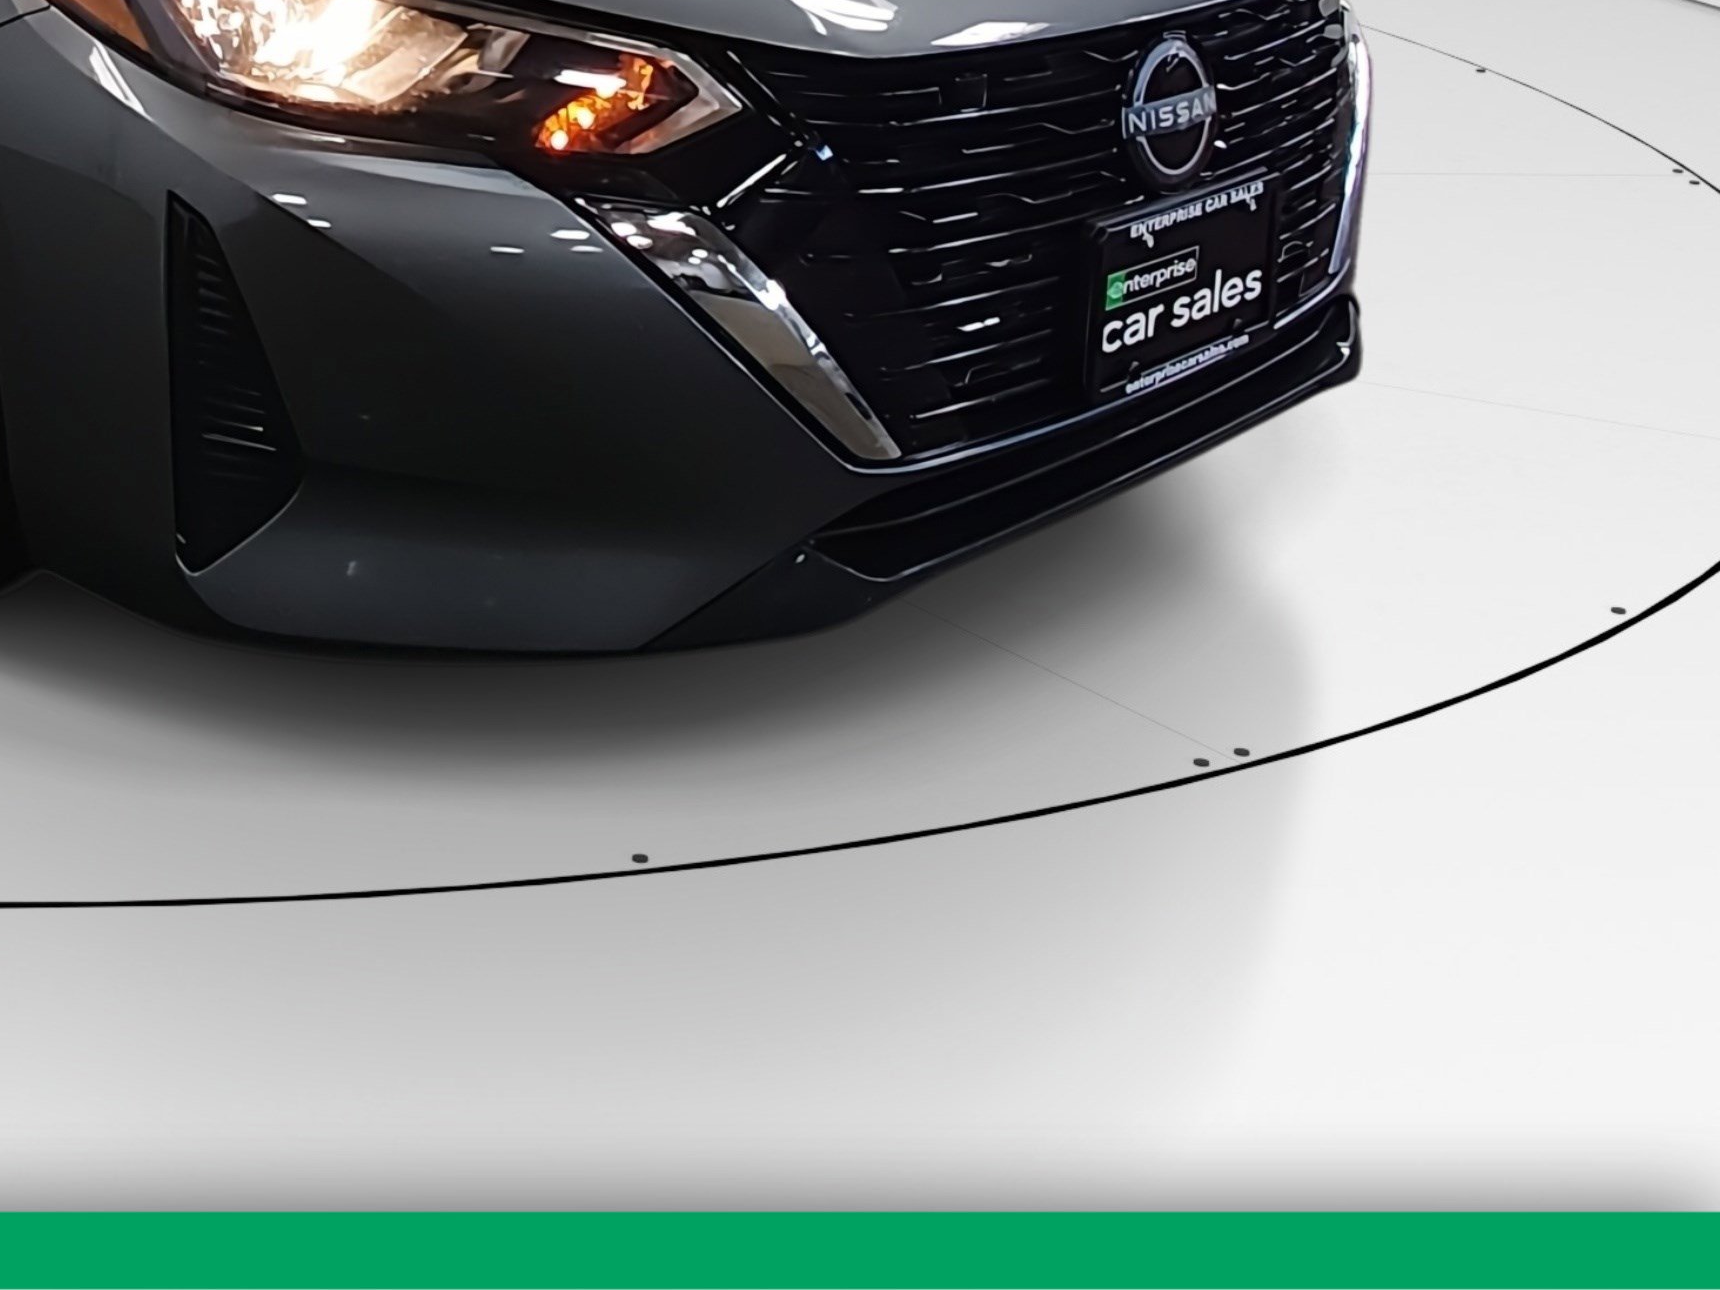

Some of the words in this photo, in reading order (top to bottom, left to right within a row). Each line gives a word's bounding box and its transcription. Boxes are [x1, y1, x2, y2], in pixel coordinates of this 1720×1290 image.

[1128, 92, 1217, 134] NISSAN
[1130, 202, 1202, 238] ENTERPRISE
[1205, 192, 1228, 213] CAR
[1106, 258, 1197, 299] enterprise
[1101, 303, 1165, 354] car
[1170, 269, 1263, 328] sales
